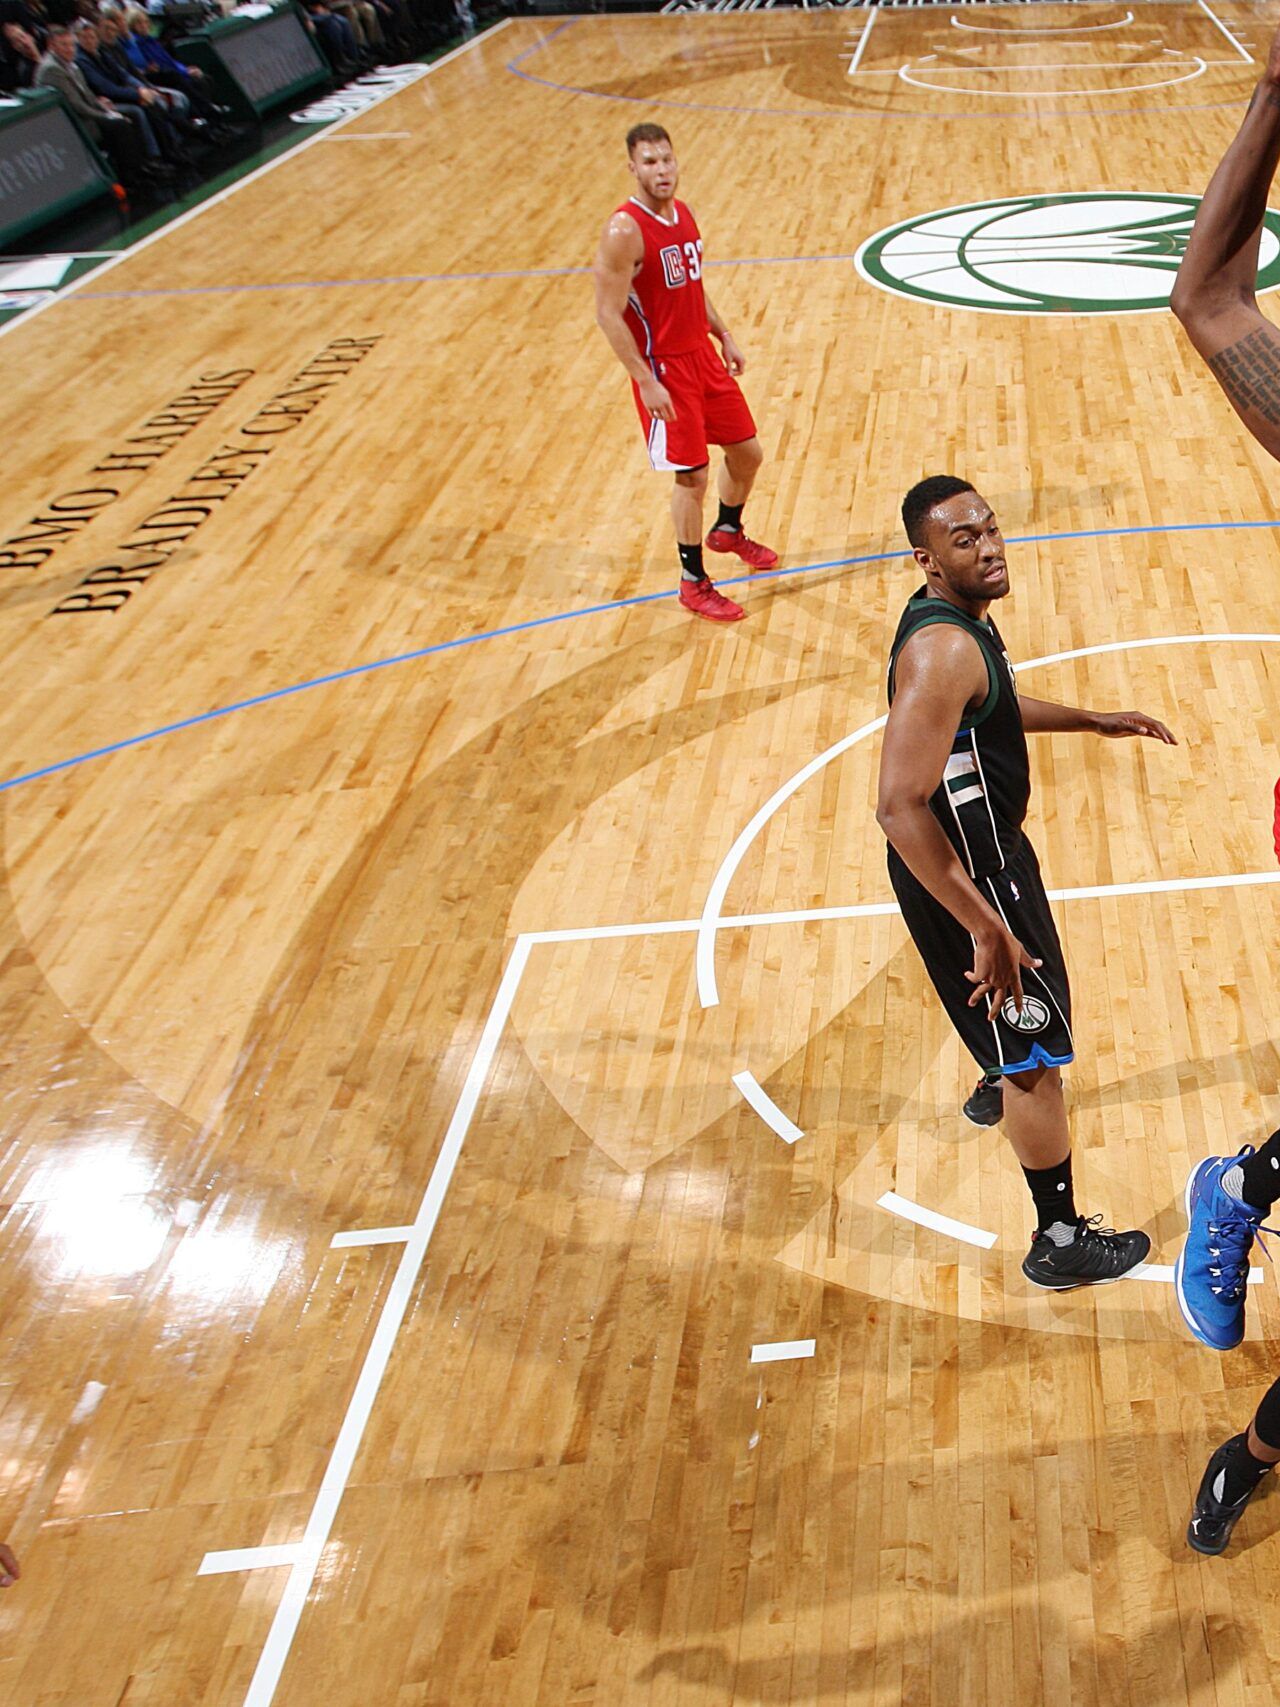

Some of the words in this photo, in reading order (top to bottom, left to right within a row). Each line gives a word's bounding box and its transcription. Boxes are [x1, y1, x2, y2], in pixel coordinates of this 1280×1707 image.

[0, 486, 119, 571] BMO
[94, 368, 256, 473] HARRIS
[49, 444, 272, 617] BRADLEY
[241, 333, 387, 435] CENTER
